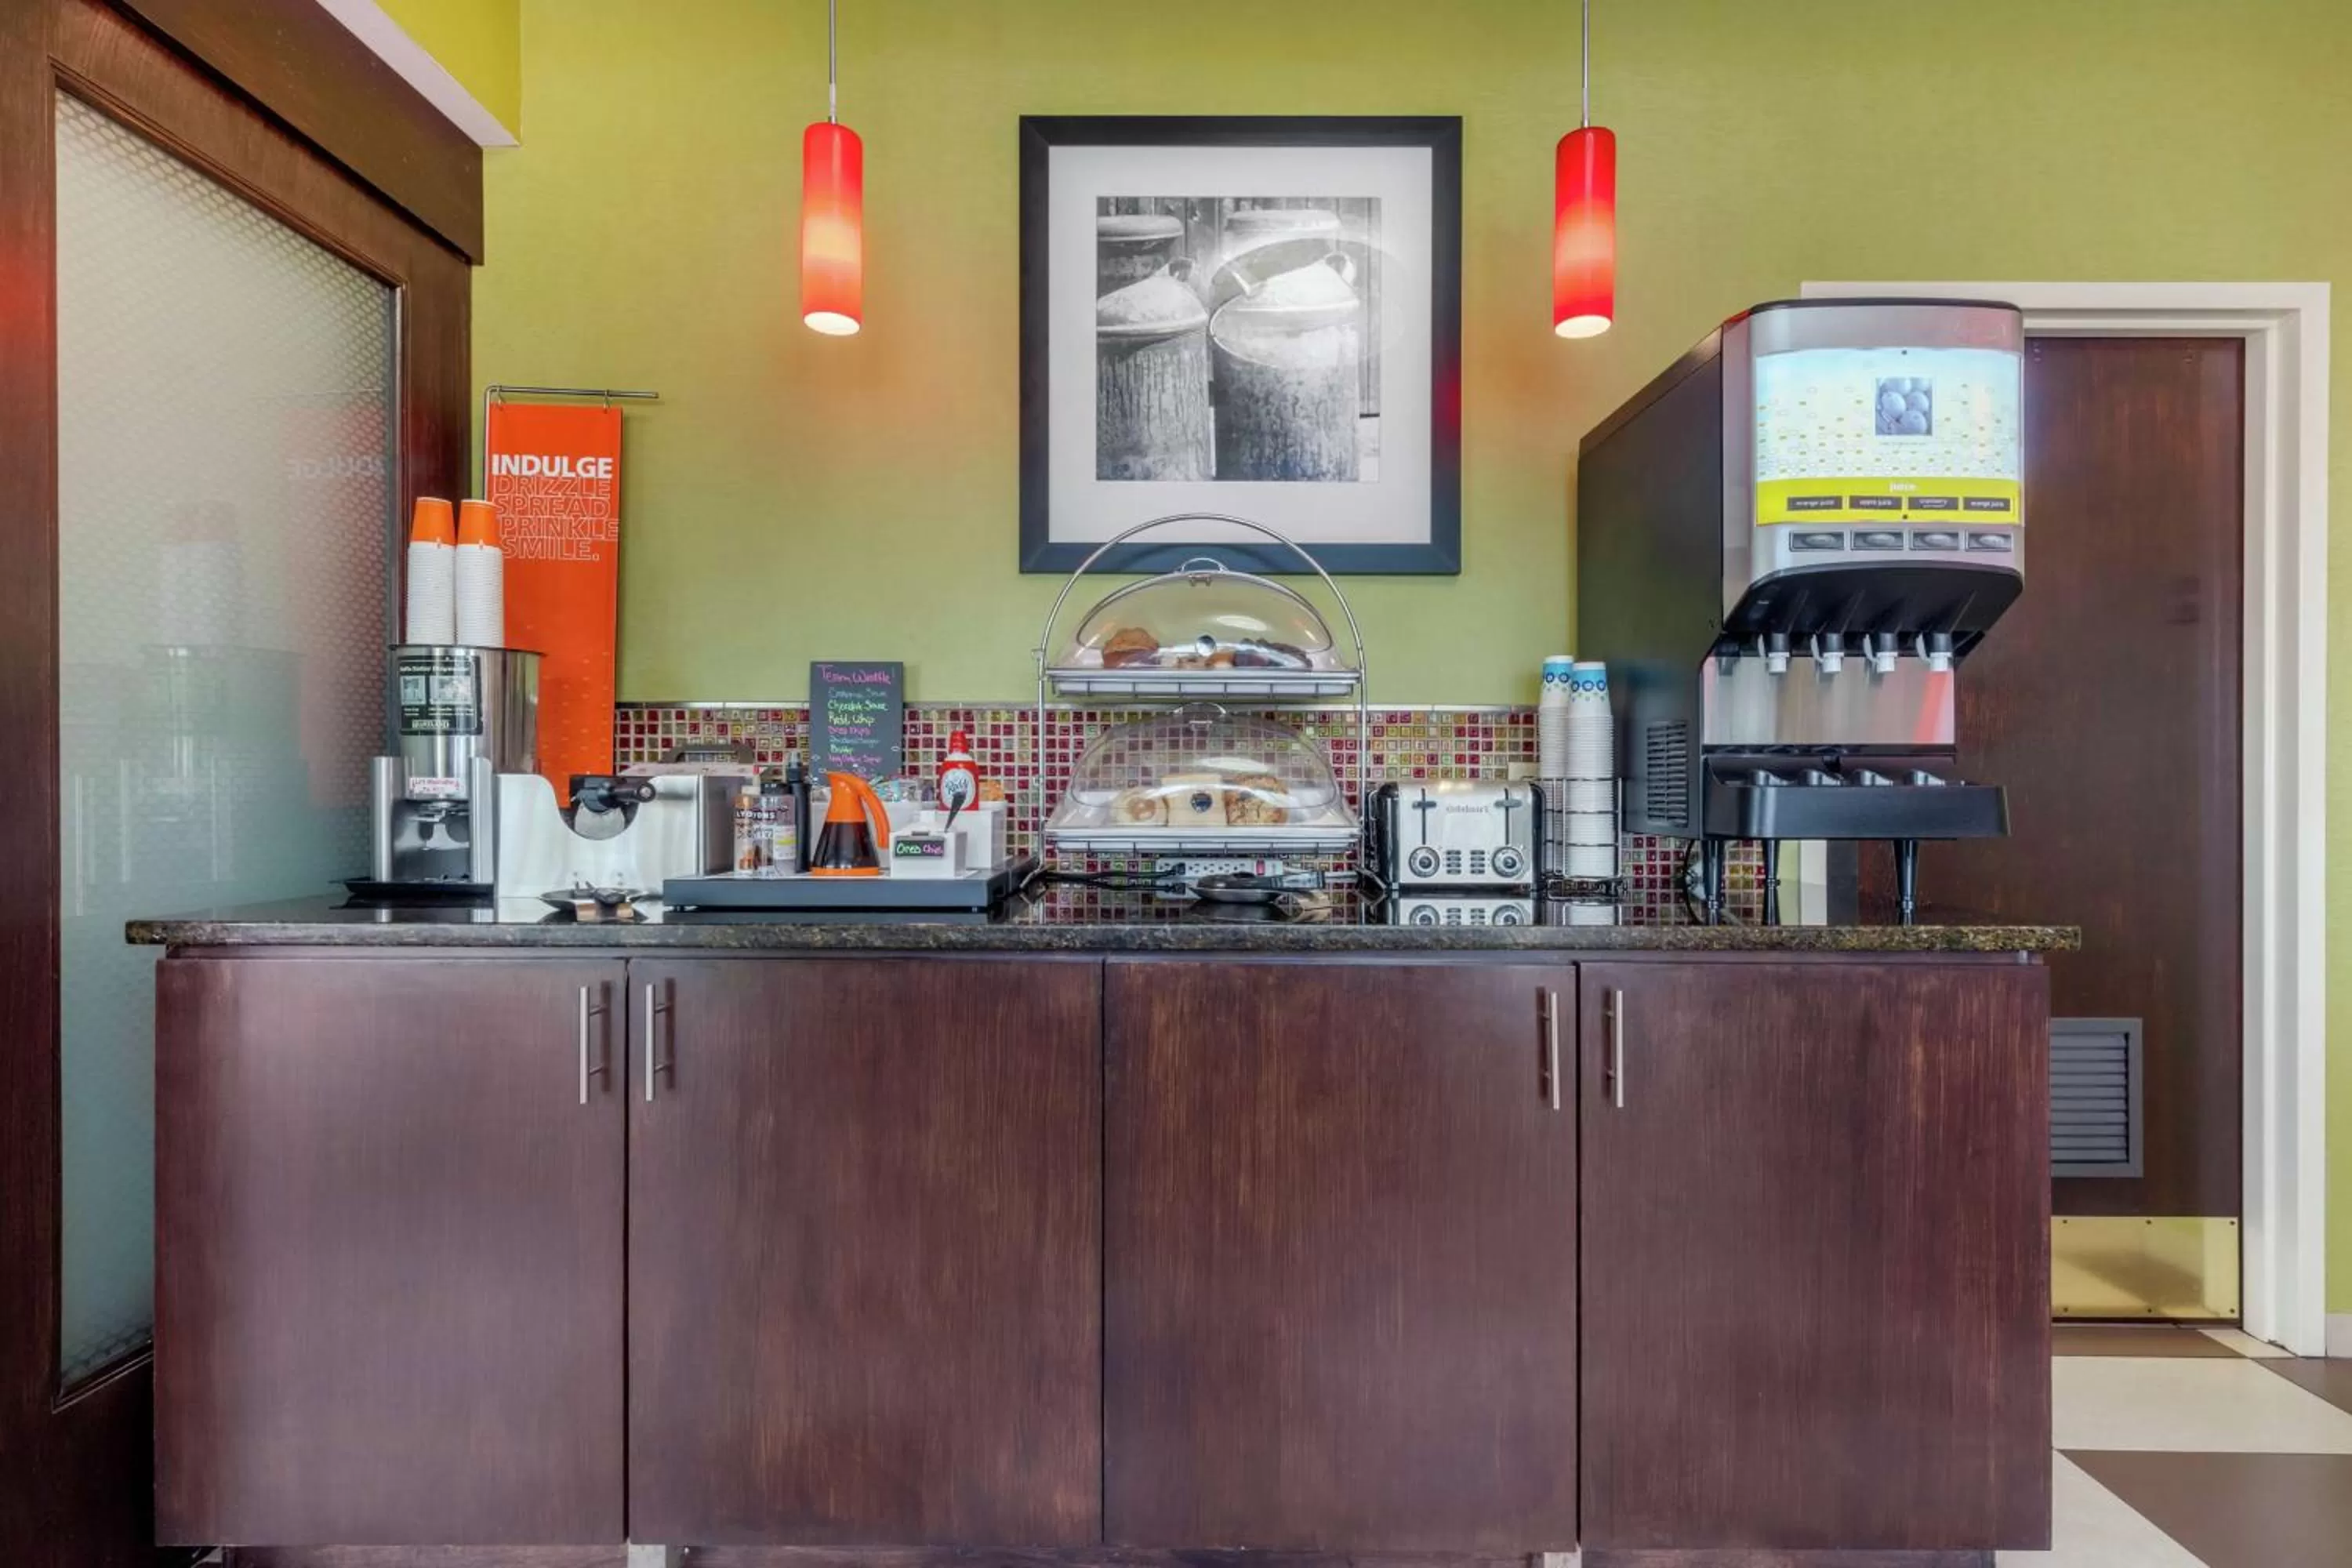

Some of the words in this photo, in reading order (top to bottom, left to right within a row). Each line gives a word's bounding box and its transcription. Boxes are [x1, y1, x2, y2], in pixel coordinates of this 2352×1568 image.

[492, 453, 614, 479] INDULGE
[493, 475, 612, 499] DRIZZLE
[492, 493, 612, 519] SPREAD
[499, 516, 622, 542] PRINKLE
[501, 536, 601, 561] SMILE.
[896, 842, 922, 855] Oreo
